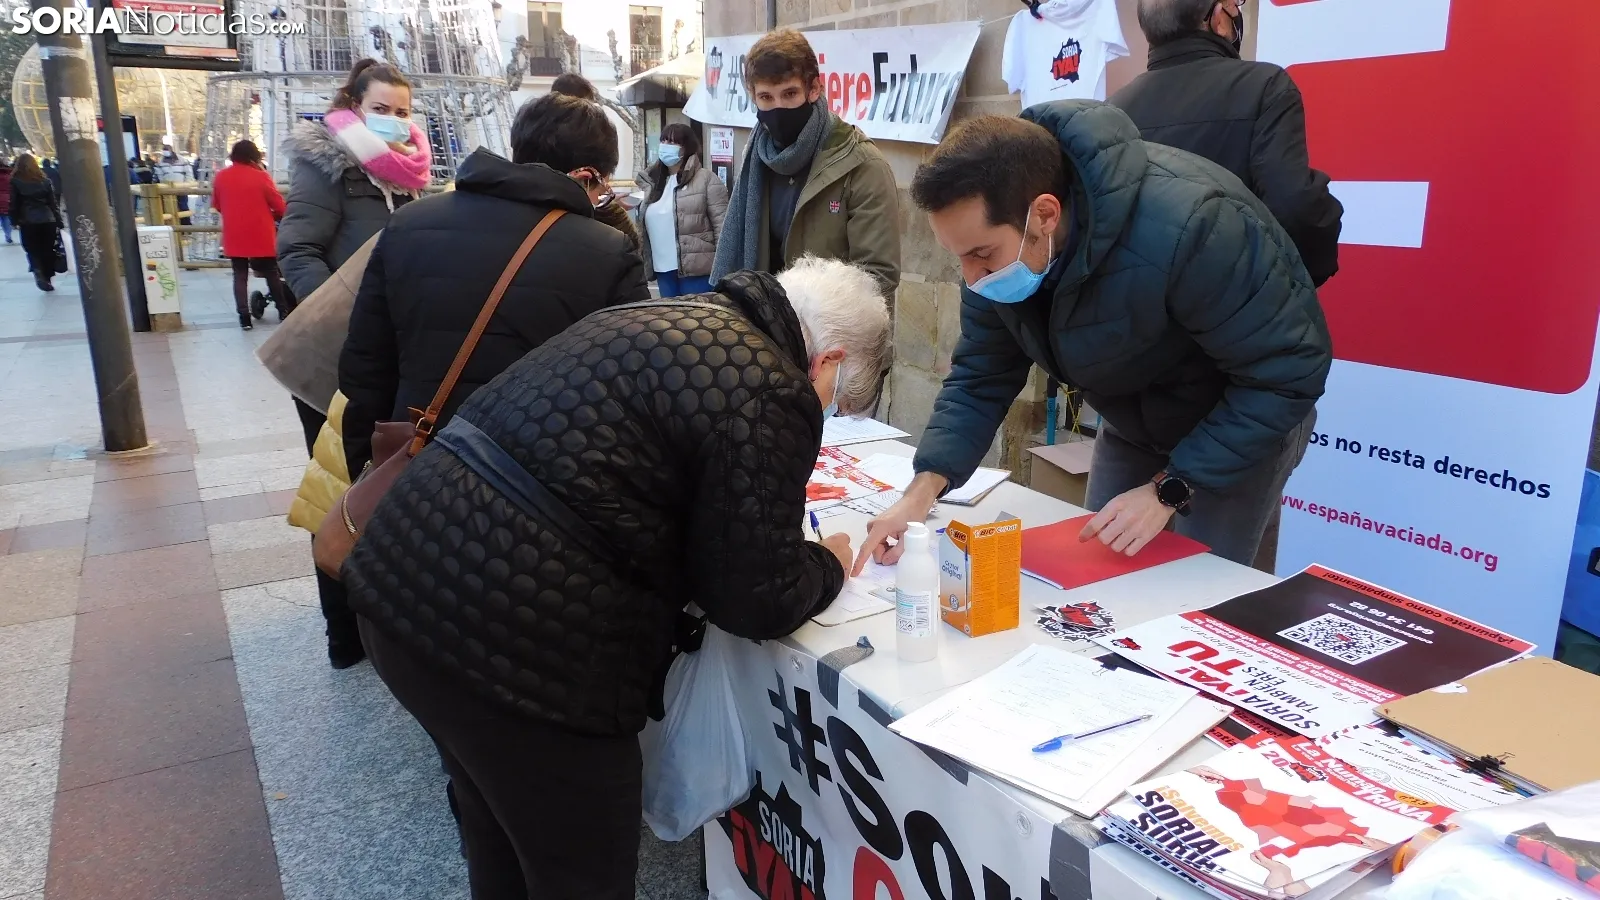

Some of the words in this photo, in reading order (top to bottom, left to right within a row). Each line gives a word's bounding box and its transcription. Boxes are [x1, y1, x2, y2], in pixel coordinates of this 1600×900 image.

[1335, 437, 1362, 454] no
[1368, 444, 1425, 470] resta
[1433, 456, 1551, 499] derechos
[1324, 572, 1404, 605] simpatizante!
[1386, 615, 1407, 628] 34
[1406, 602, 1443, 619] como
[1445, 616, 1515, 644] ¡Apúntate
[1165, 640, 1246, 676] TÚ
[1266, 645, 1301, 661] email
[1300, 660, 1325, 670] por
[1174, 666, 1250, 697] ¡YA!
[1241, 666, 1287, 688] ERES
[1309, 669, 1339, 683] toda
[1321, 668, 1397, 699] plataforma
[1243, 678, 1320, 714] TAMBIÉN
[1340, 682, 1387, 702] Recibe
[1241, 694, 1320, 730] SORIA
[1261, 750, 1289, 767] 20
[1134, 790, 1233, 861] SORIA!
[1154, 785, 1245, 852] ¡Salvemos
[758, 800, 816, 896] SORIA
